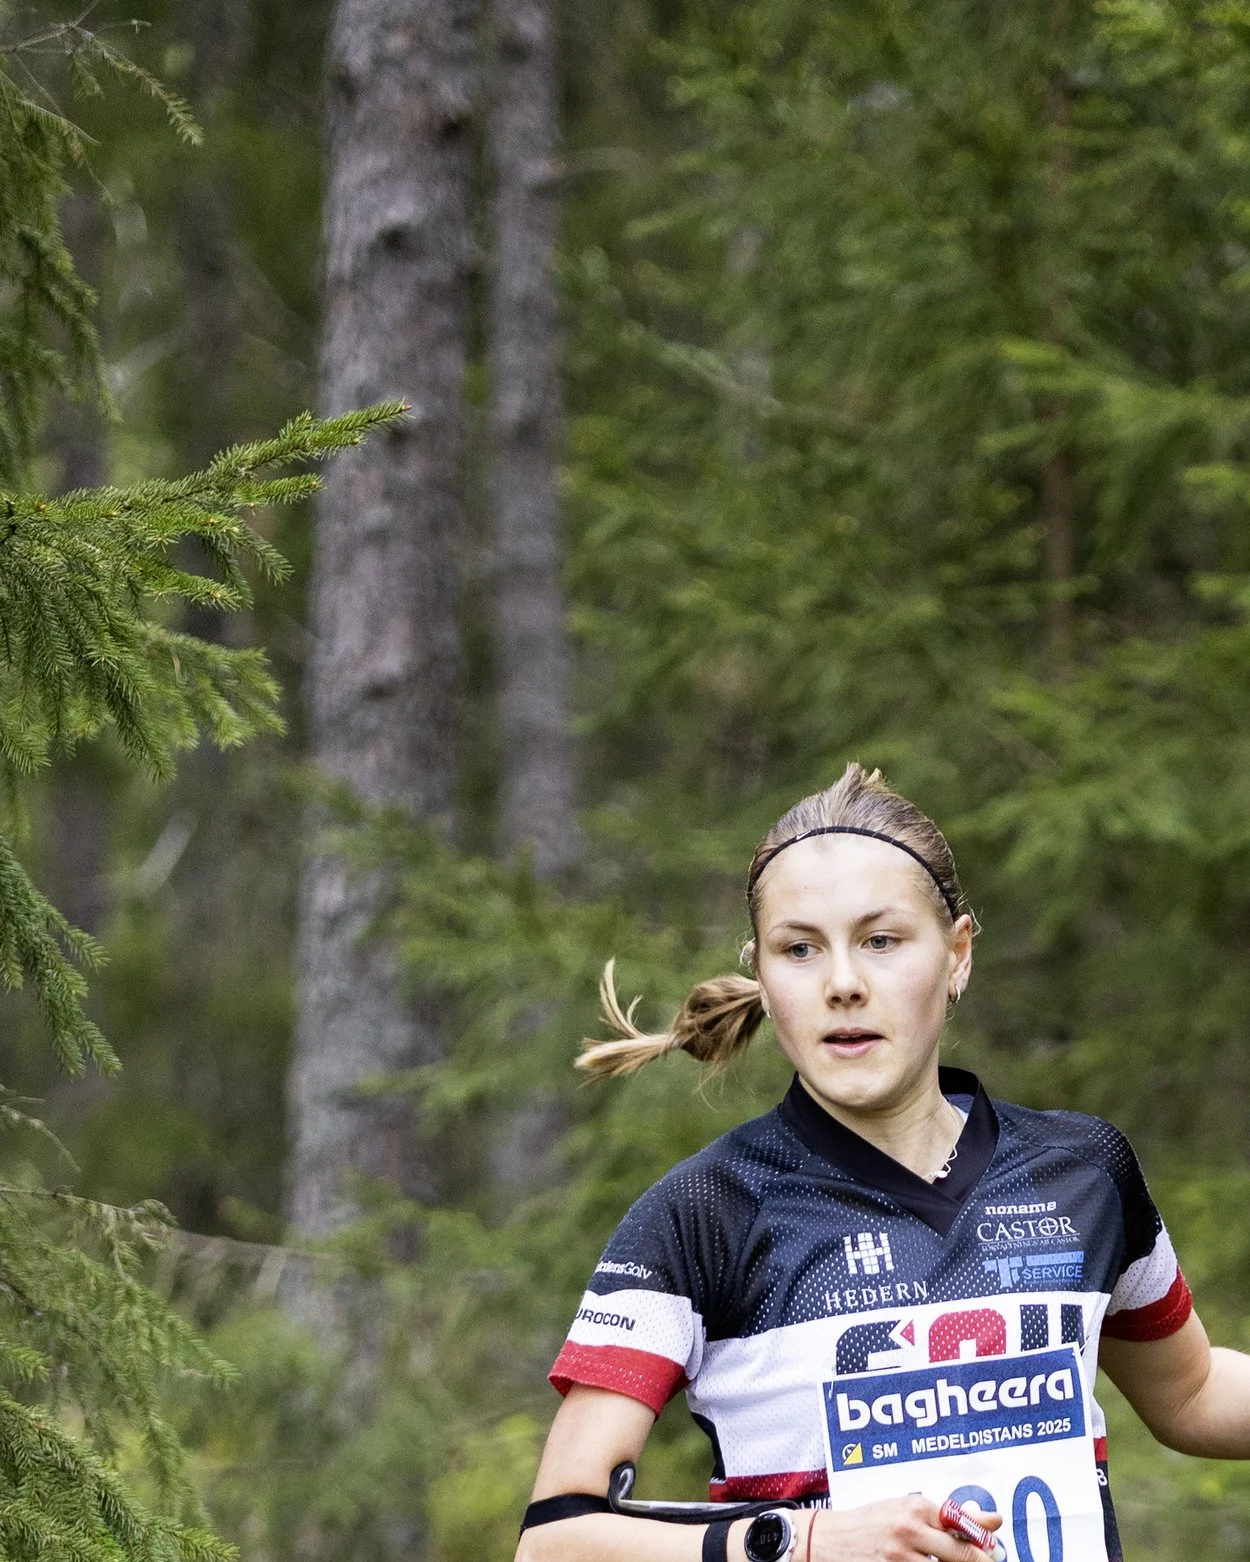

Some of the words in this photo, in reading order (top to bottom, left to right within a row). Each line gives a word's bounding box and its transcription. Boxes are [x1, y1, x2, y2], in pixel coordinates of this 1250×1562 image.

[985, 1201, 1057, 1215] noname
[977, 1217, 1077, 1241] CASTOR
[1023, 1265, 1083, 1280] SERVICE
[825, 1280, 929, 1311] HEDERN
[836, 1368, 1074, 1431] bagheera
[872, 1441, 898, 1459] SM
[911, 1427, 1033, 1454] MEDELDISTANS
[1037, 1417, 1072, 1436] 2025
